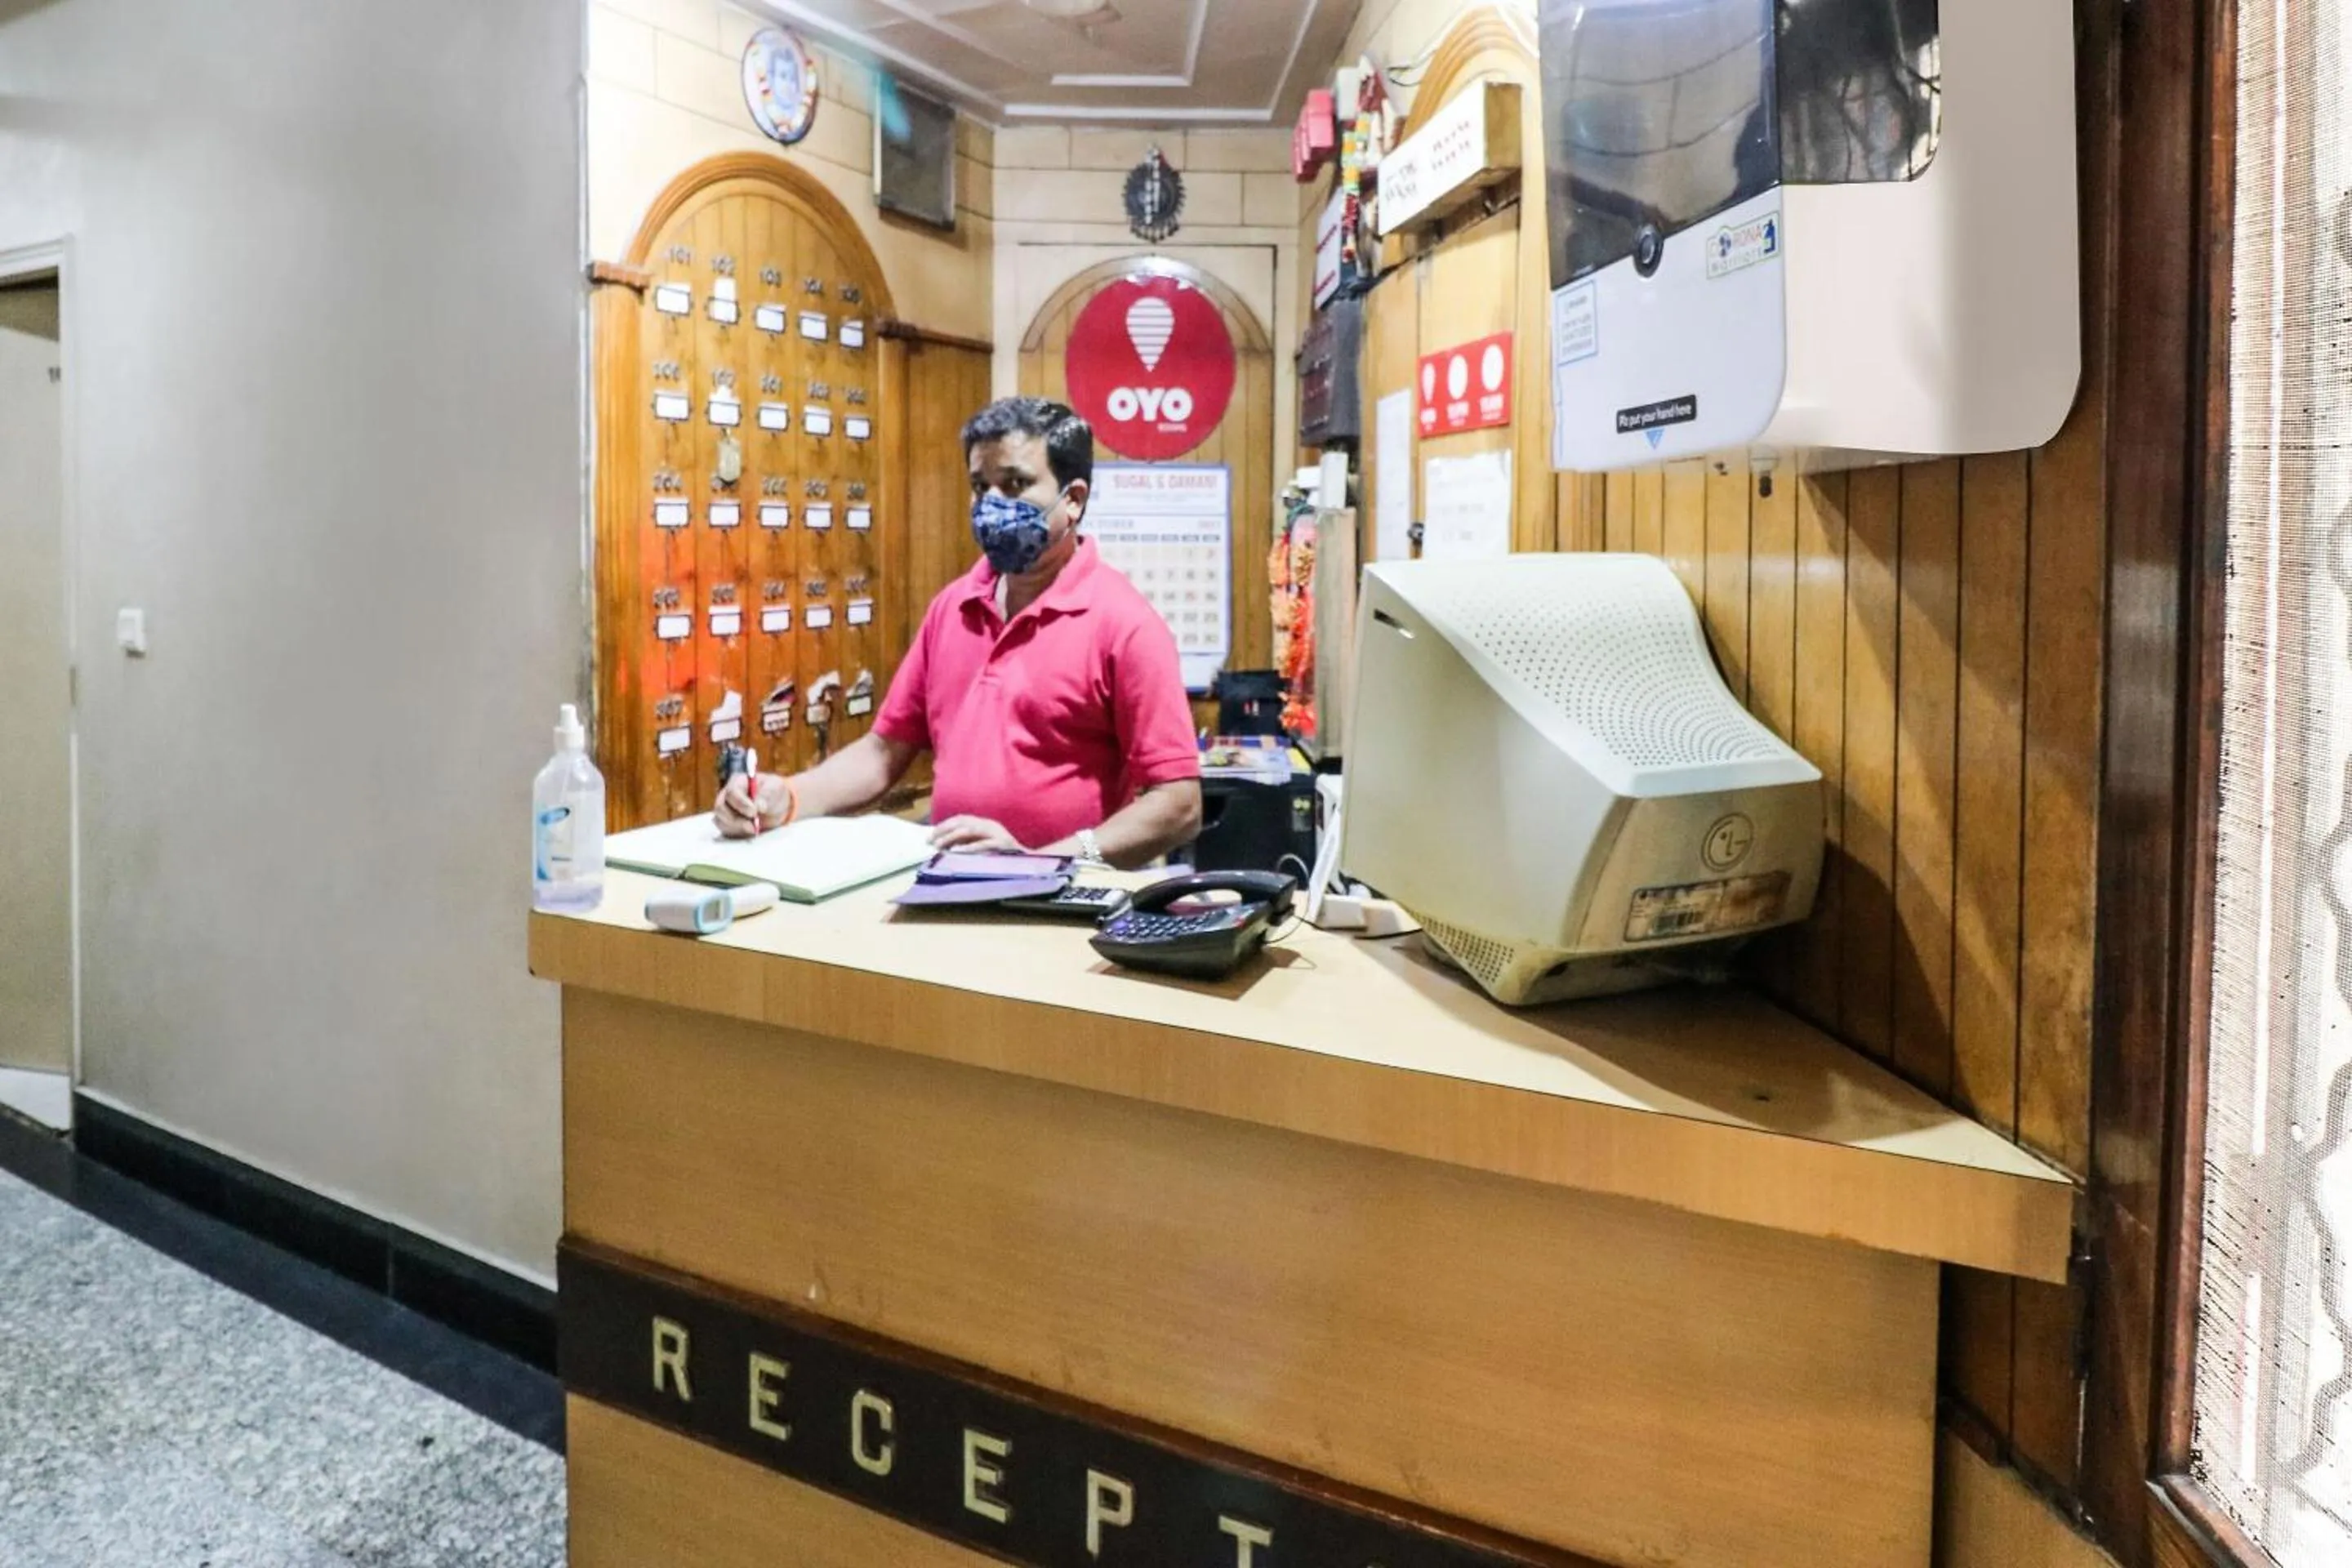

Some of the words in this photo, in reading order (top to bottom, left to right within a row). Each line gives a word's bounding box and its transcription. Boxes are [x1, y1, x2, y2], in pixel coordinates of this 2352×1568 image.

[1107, 387, 1193, 421] OYO
[1628, 413, 1641, 428] put
[1641, 411, 1656, 426] your
[1656, 403, 1674, 420] hand
[1675, 403, 1692, 417] here
[652, 1316, 1385, 1568] RECEPT
